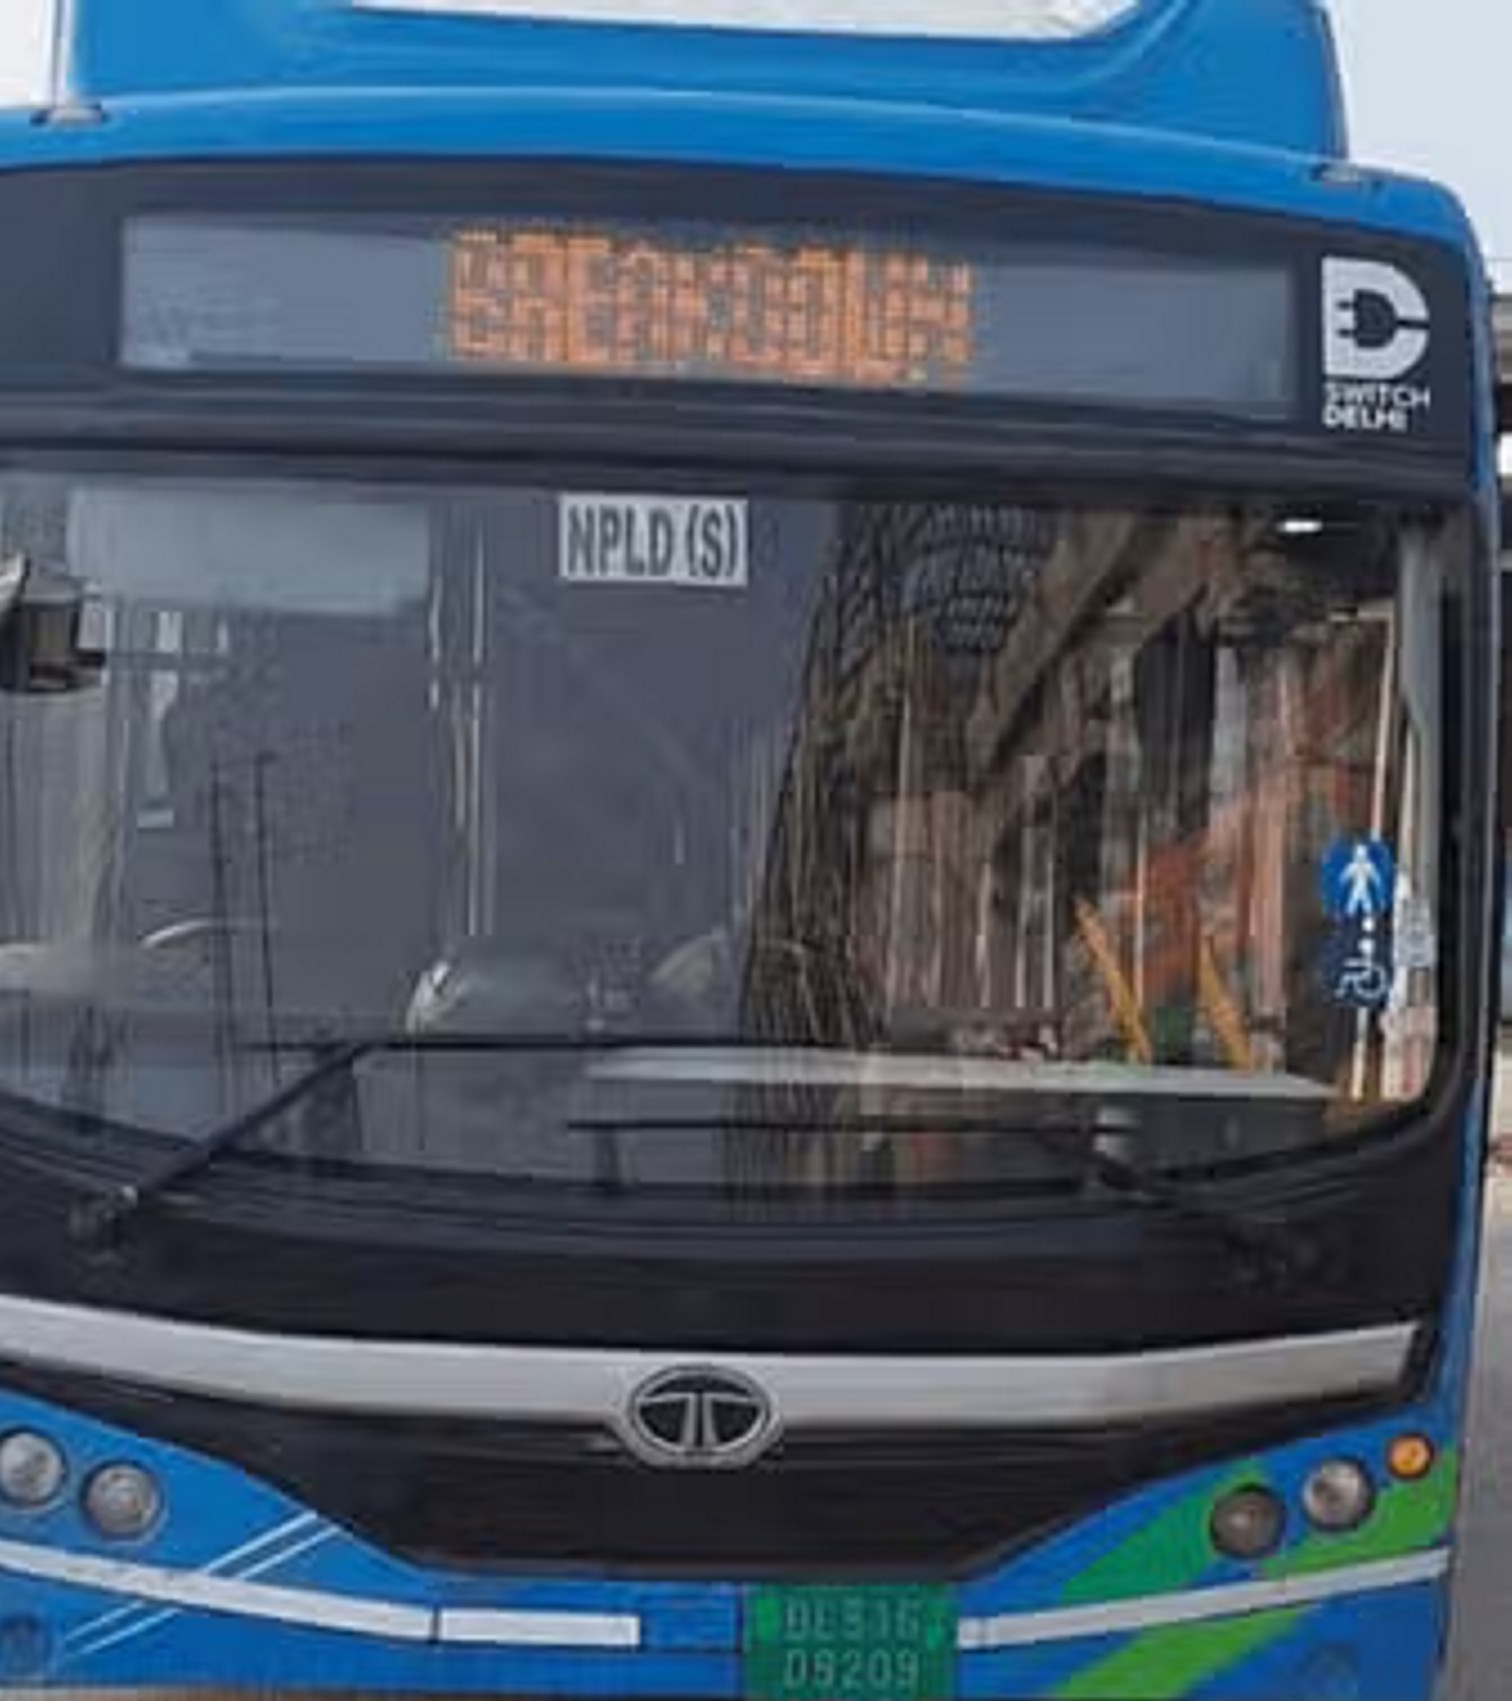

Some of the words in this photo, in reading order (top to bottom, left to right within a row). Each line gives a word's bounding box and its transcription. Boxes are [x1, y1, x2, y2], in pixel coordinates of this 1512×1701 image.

[450, 228, 974, 392] BREAKDOWN
[1322, 405, 1408, 431] DELHI
[1323, 382, 1432, 410] SWITCH
[567, 503, 675, 577] NPLD
[685, 502, 737, 580] (S)
